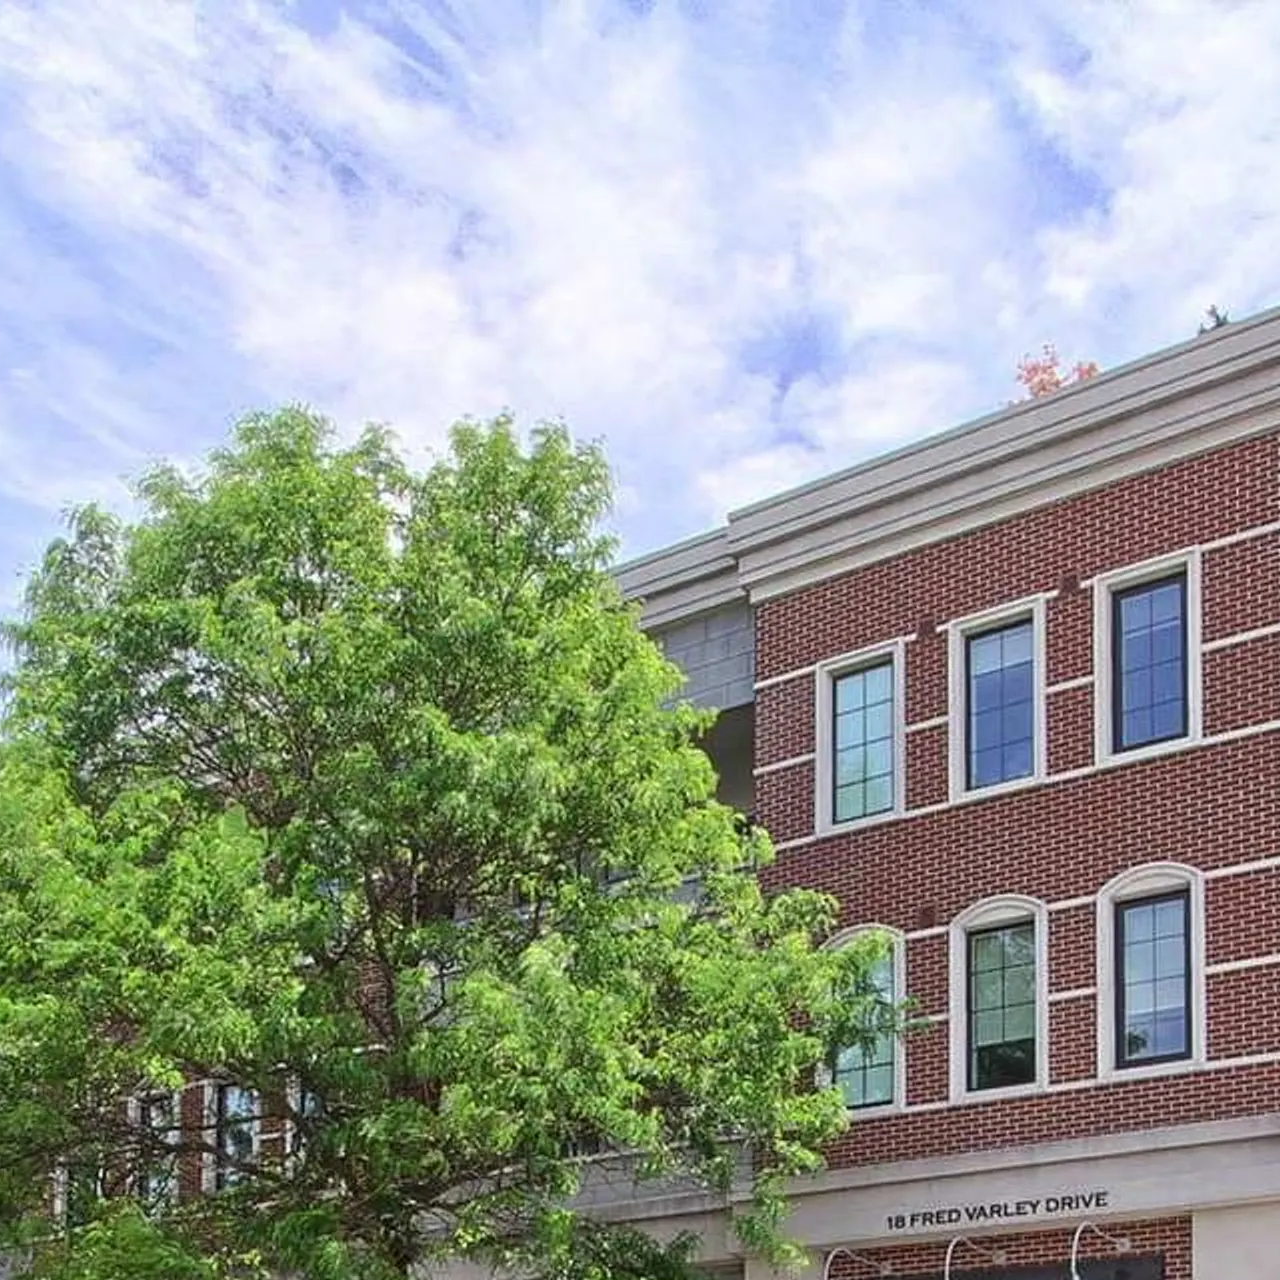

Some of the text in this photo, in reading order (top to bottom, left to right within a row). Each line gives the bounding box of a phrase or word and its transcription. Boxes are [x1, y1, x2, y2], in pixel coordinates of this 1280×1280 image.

[887, 1191, 1109, 1230] 18 FRED VARLEY DRIVE
